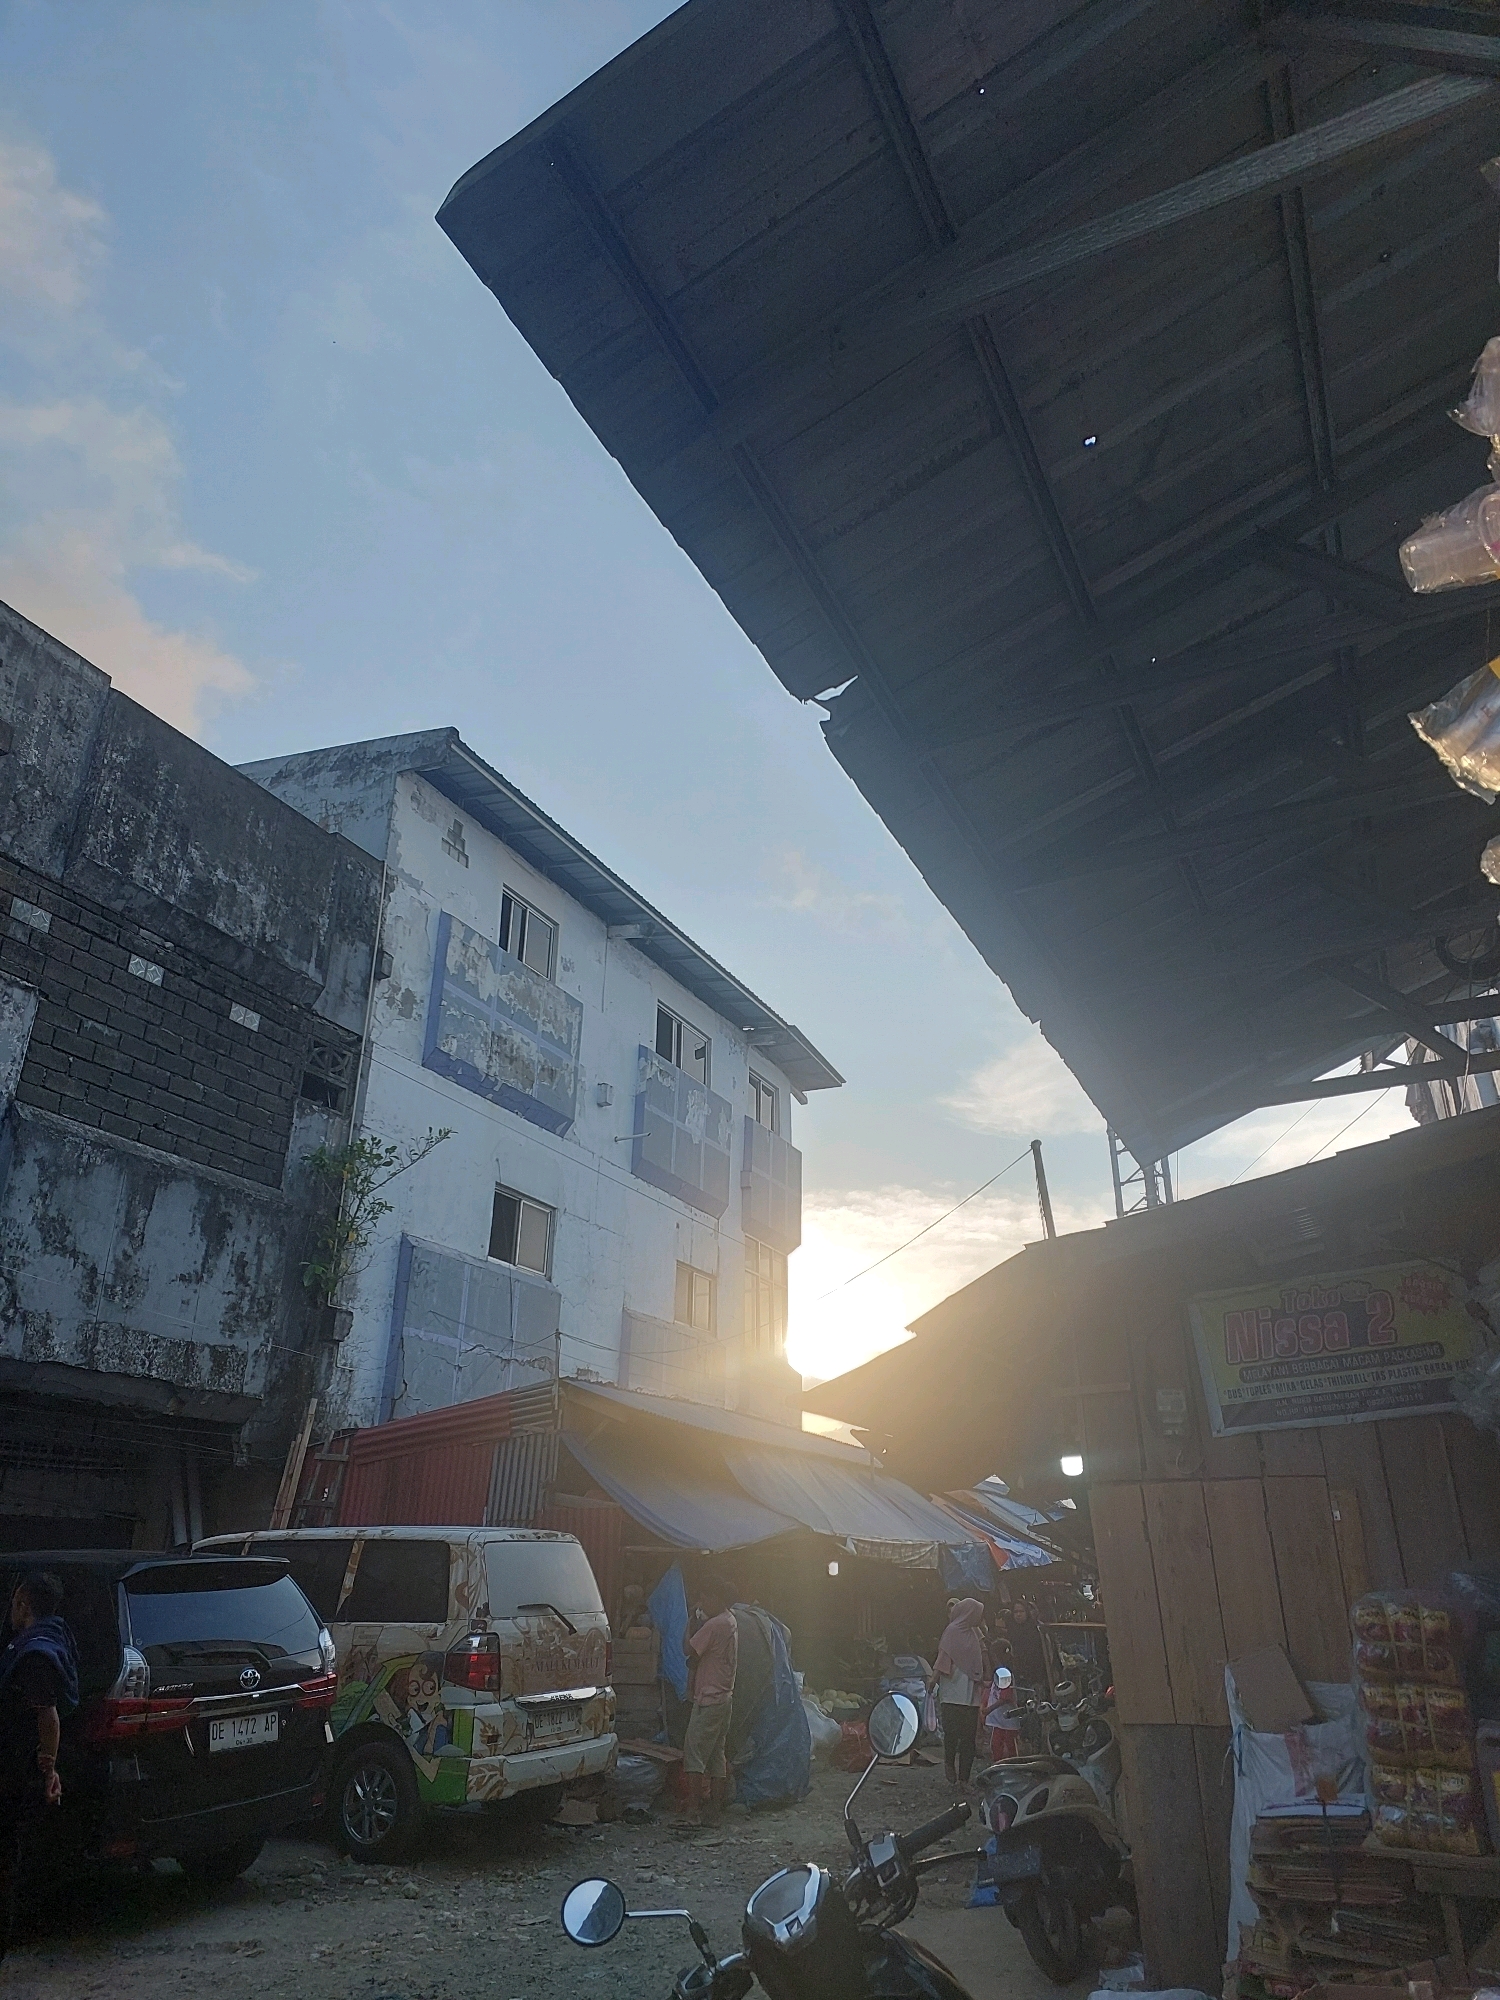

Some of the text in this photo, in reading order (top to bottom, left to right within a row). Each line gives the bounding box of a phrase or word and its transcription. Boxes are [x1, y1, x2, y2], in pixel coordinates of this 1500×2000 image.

[1281, 1285, 1341, 1313] Toko
[1225, 1290, 1397, 1364] Nissa 2
[1242, 1345, 1441, 1381] MELAYANI BERBAGAI MACAM PACKAGING
[211, 1714, 277, 1741] DE 1472 AP
